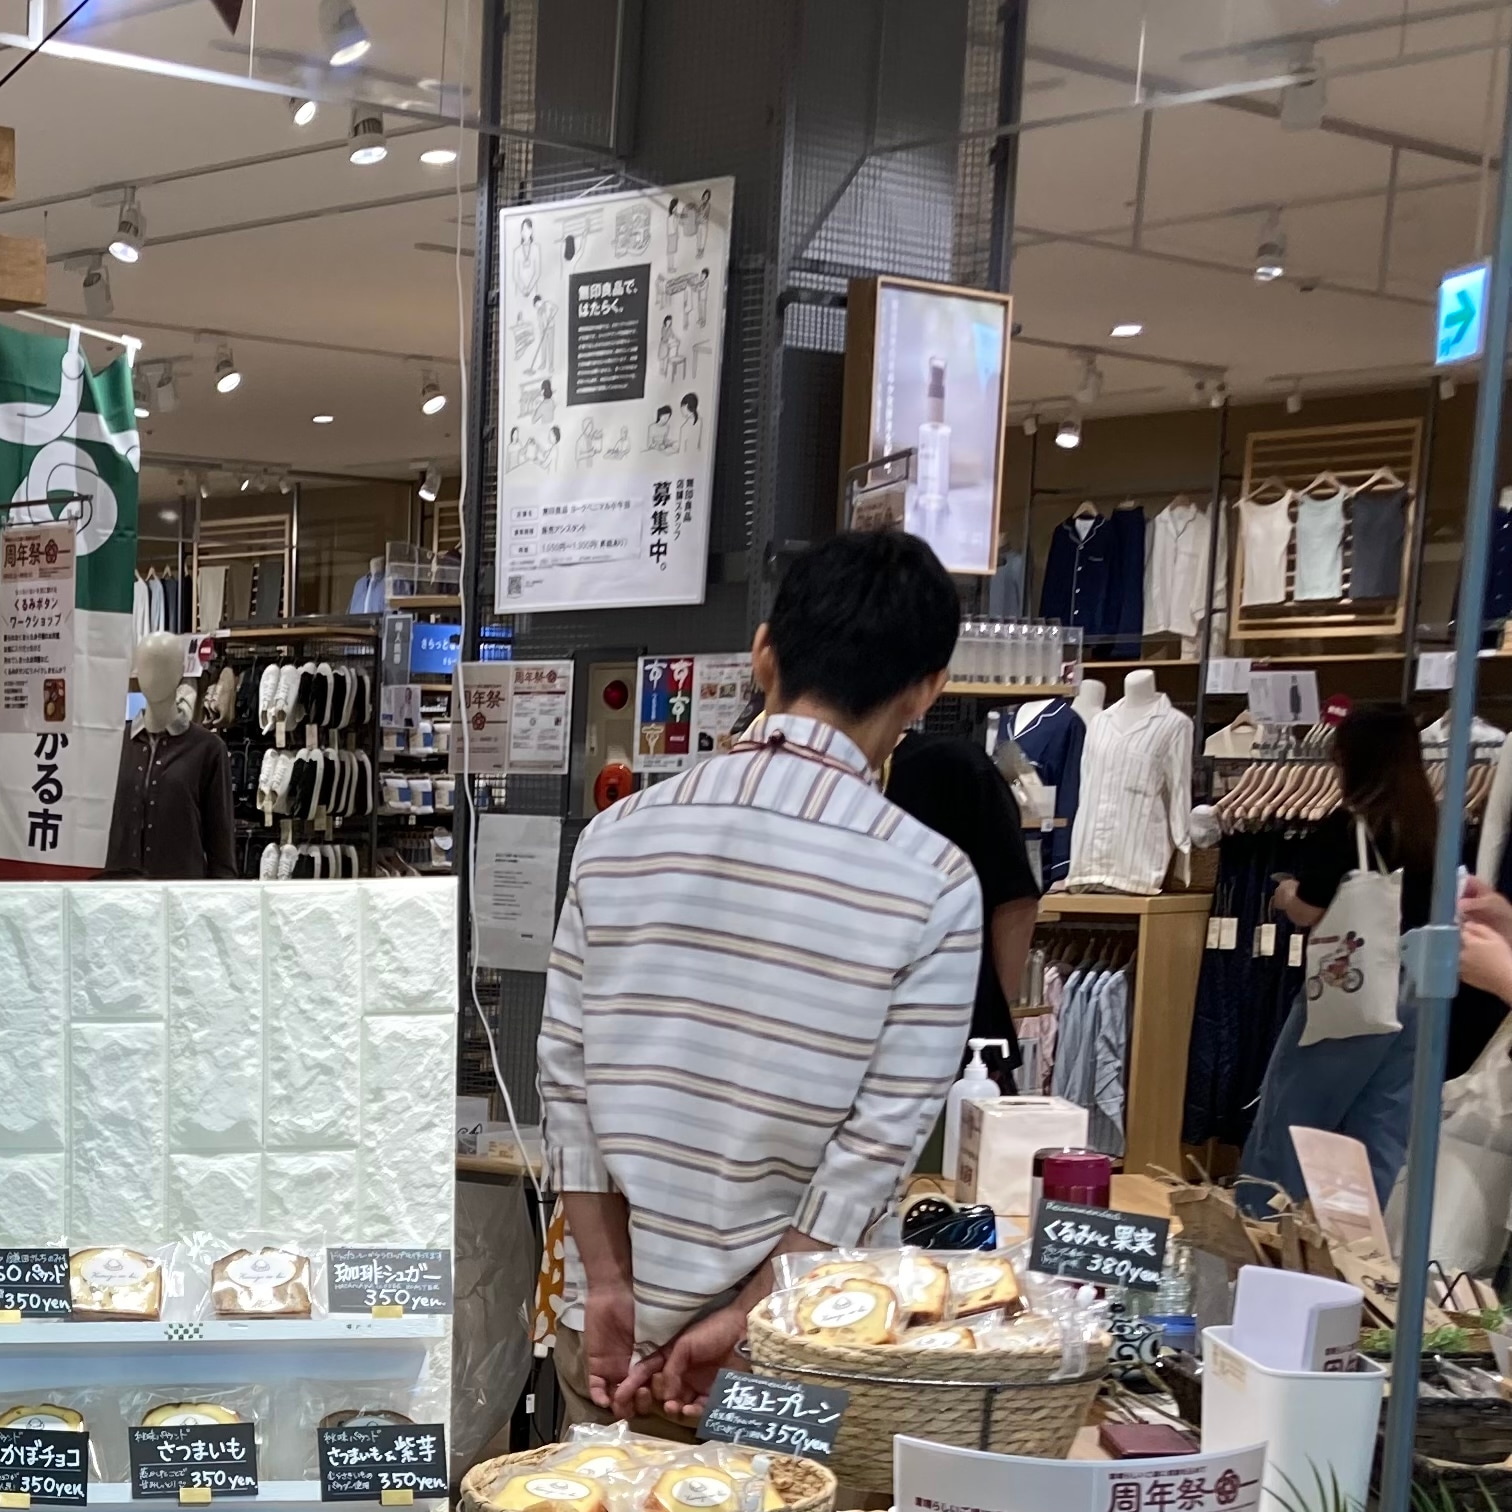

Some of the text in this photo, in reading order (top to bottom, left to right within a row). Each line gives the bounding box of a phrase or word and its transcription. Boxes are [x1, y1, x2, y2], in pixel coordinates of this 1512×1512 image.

[650, 481, 672, 571] 募集中。
[4, 543, 41, 568] 周年祭
[14, 598, 58, 611] くるみボタン
[9, 613, 62, 628] ワークショップ
[28, 732, 69, 852] がる市
[334, 1259, 442, 1284] 珈琲シュガー
[722, 1381, 841, 1424] 極上プレーン
[156, 1437, 246, 1462] さつまいも
